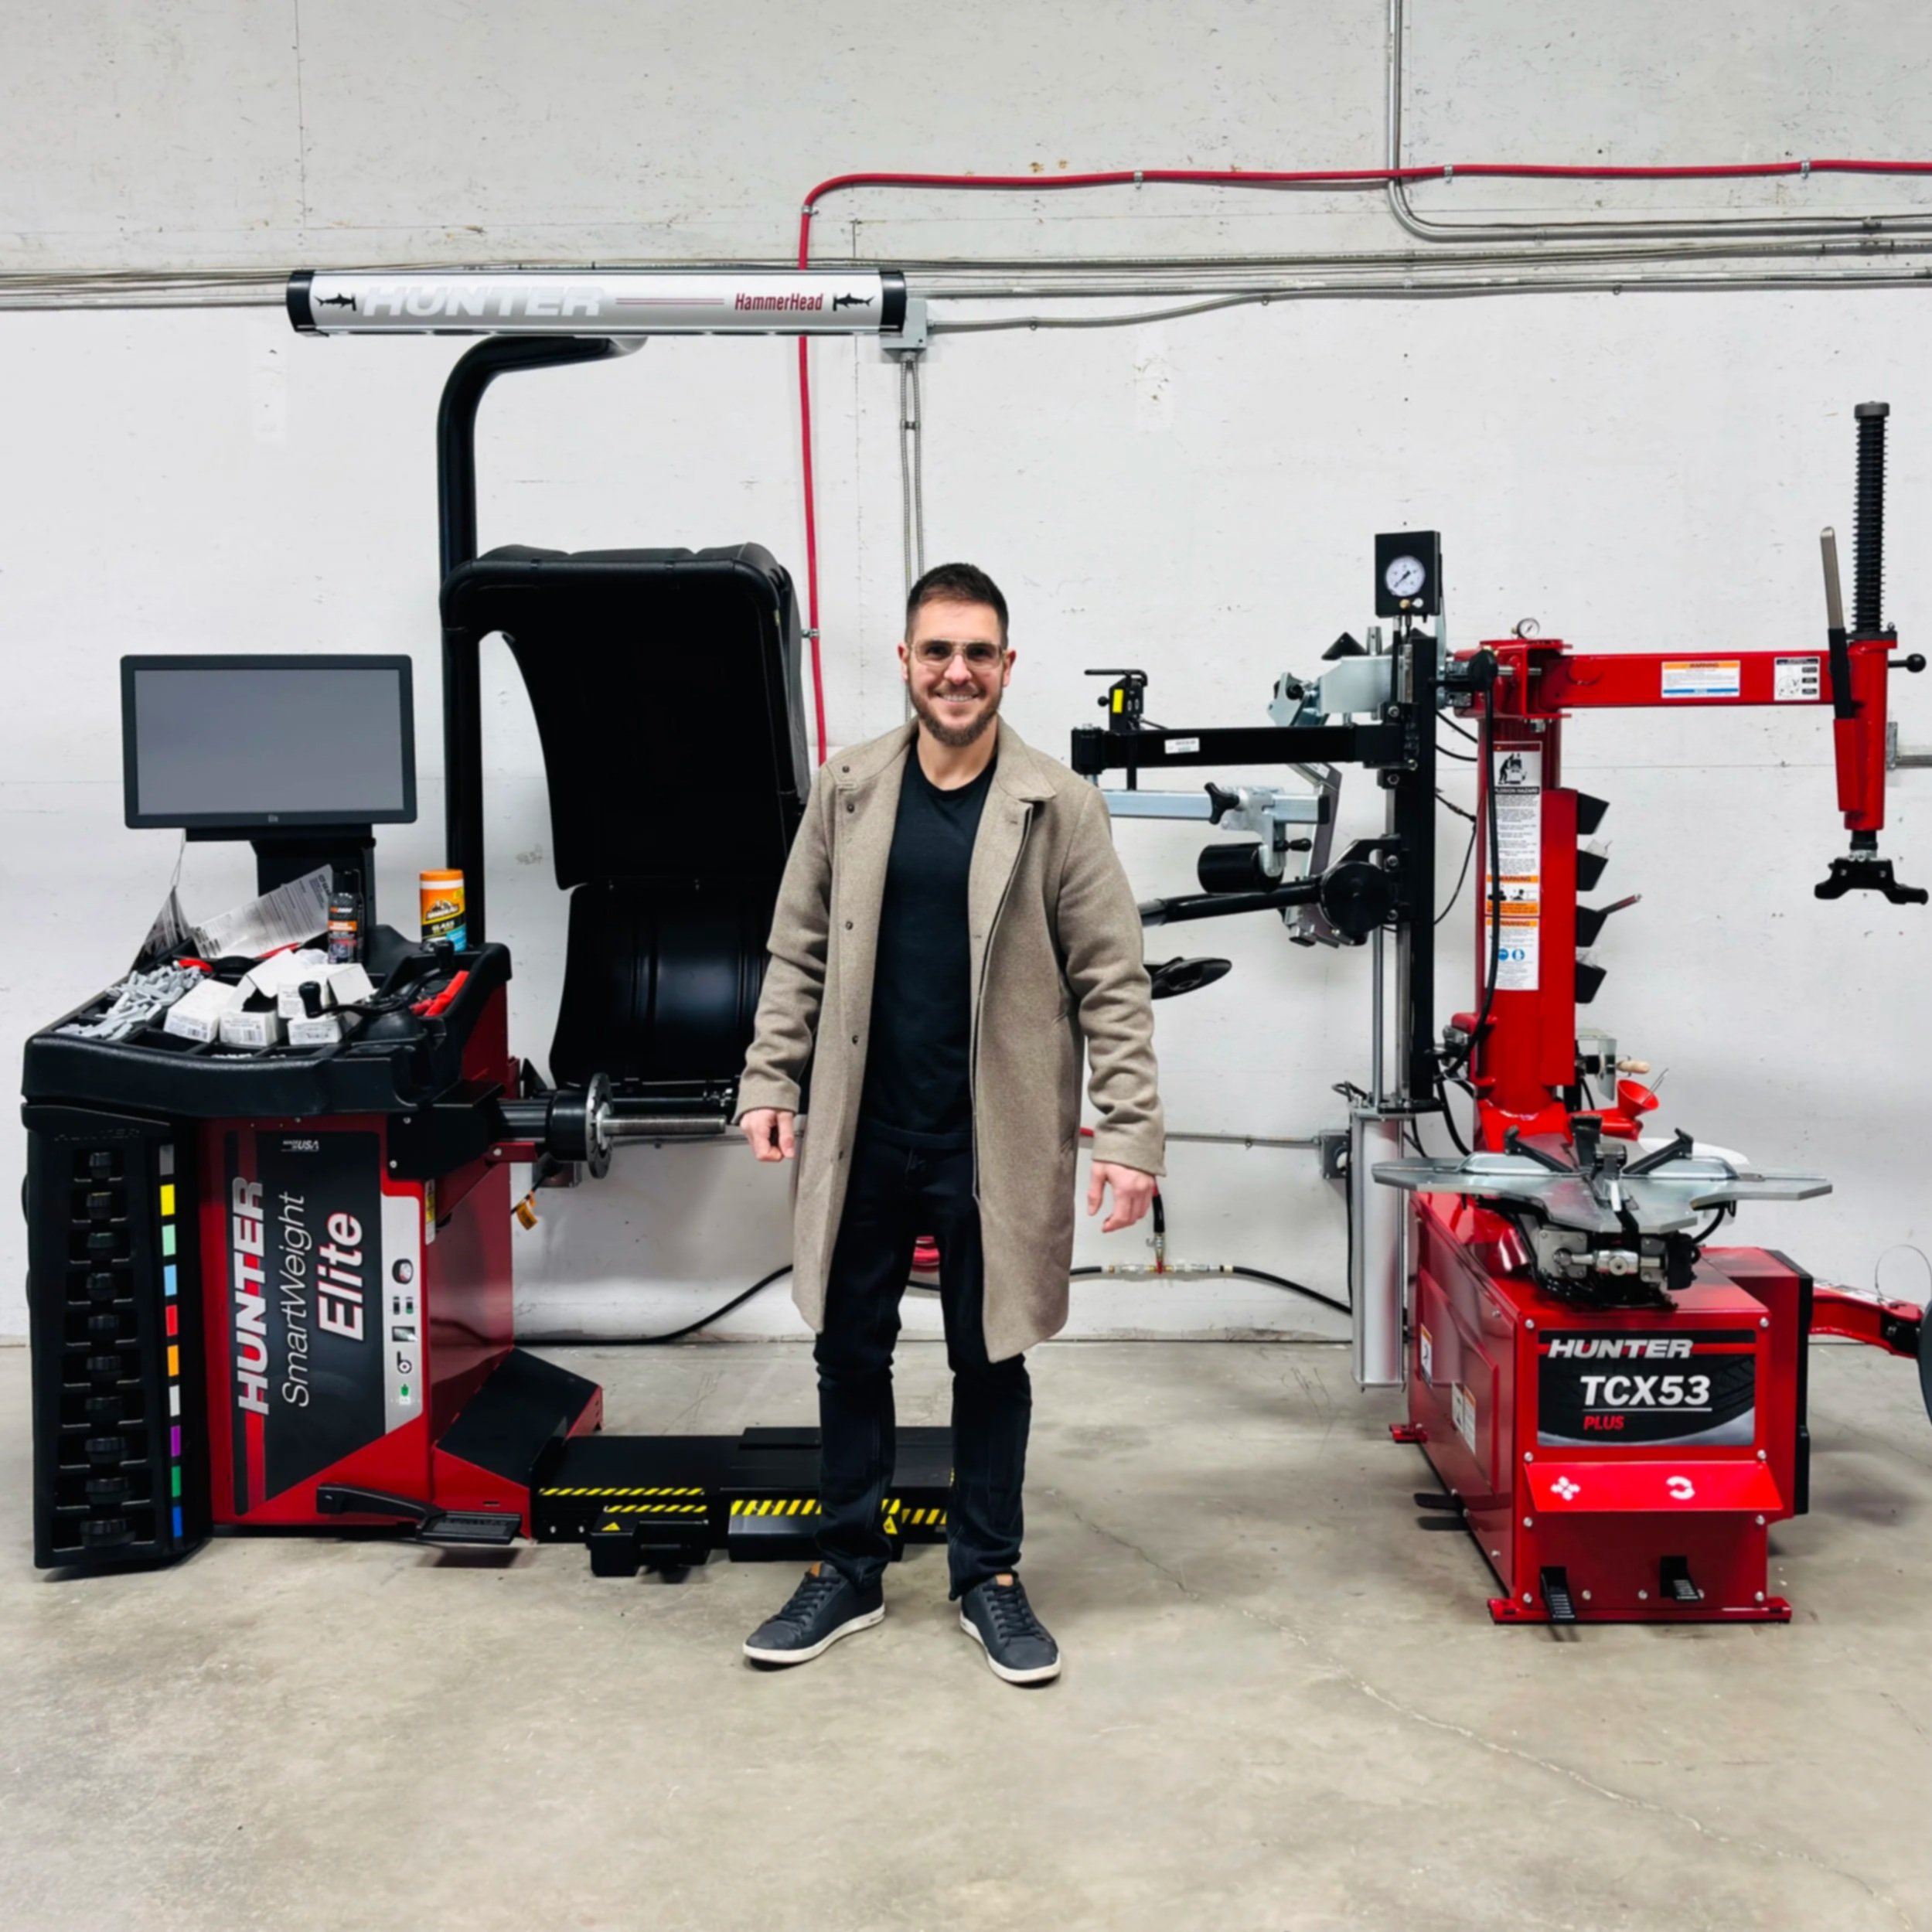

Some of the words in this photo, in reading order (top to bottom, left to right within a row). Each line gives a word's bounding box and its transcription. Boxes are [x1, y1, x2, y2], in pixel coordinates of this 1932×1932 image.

[363, 286, 604, 317] HUNTER
[734, 293, 823, 311] HammerHead
[317, 1211, 363, 1341] Elite
[233, 1177, 269, 1416] HUNTER
[278, 1191, 312, 1407] SmartWeight
[1547, 1338, 1693, 1358] HUNTER
[1579, 1375, 1711, 1406] TCX53
[1583, 1416, 1624, 1430] PLUS
